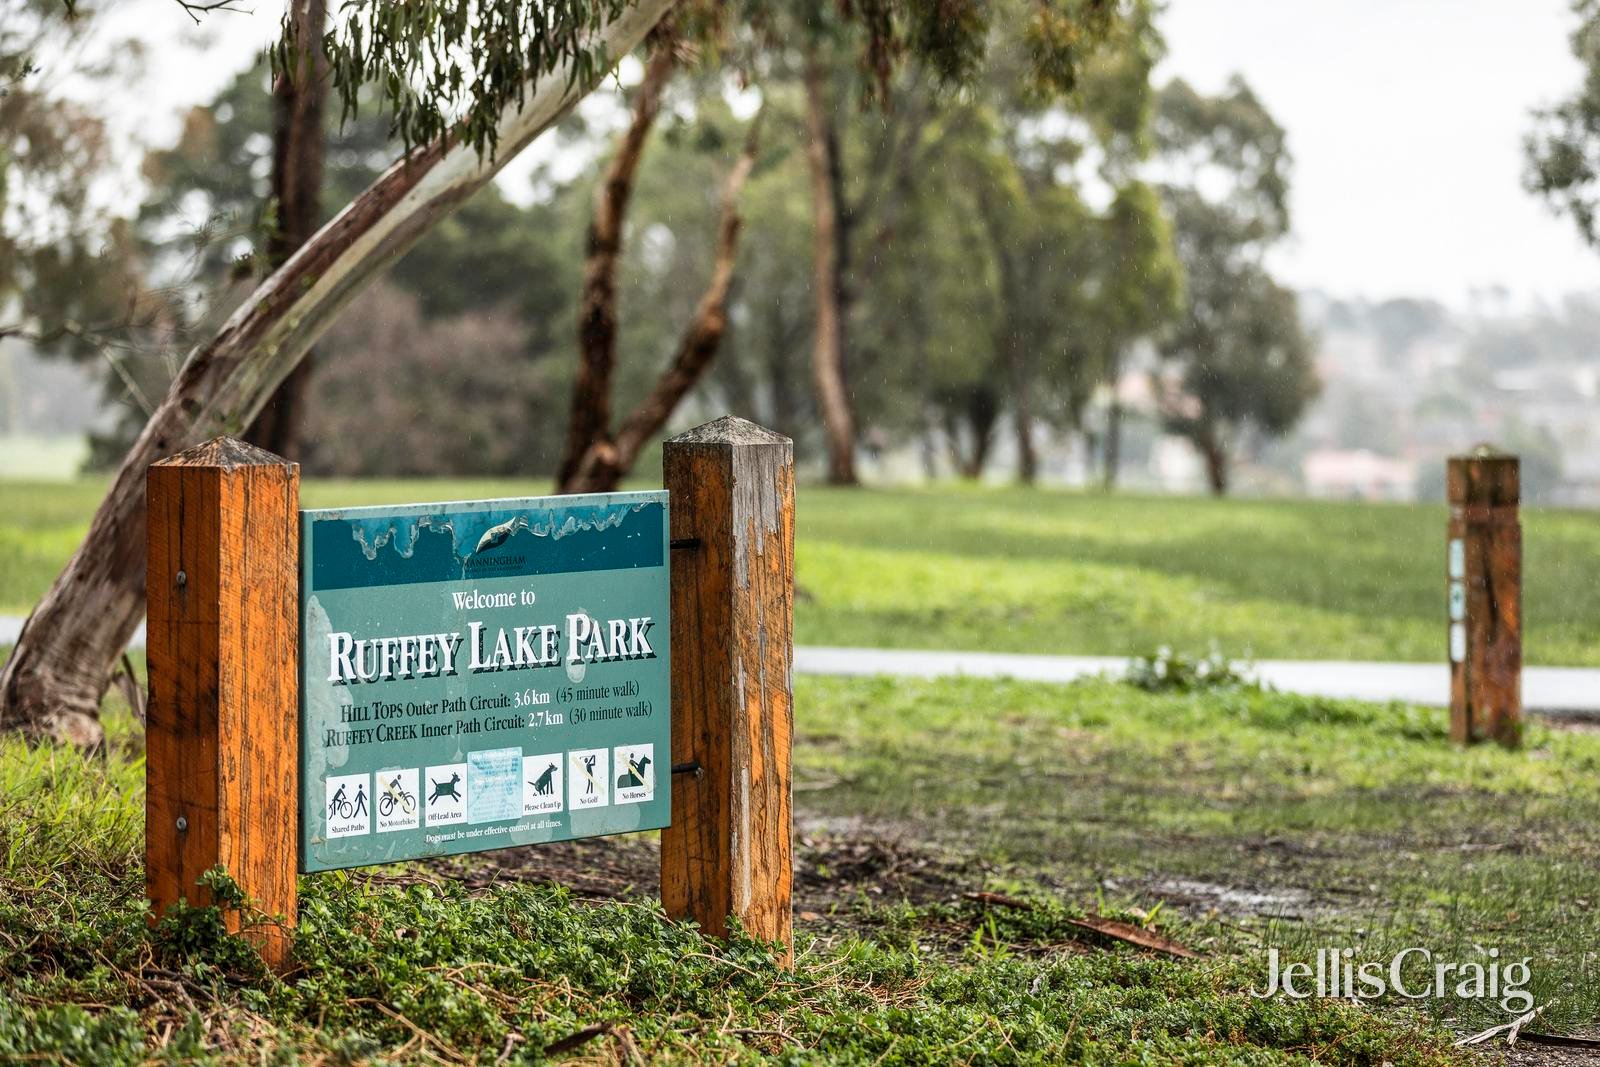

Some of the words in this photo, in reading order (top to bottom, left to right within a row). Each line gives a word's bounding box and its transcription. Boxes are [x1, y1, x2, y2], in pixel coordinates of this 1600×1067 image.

[452, 589, 516, 610] Welcome
[521, 589, 535, 604] to
[327, 632, 462, 684] RUFFEY
[468, 621, 559, 671] LAKE
[566, 613, 655, 663] PARK
[341, 704, 370, 723] HILL
[372, 701, 403, 720] TOPS
[406, 702, 438, 716] Outer
[441, 696, 466, 714] Path
[470, 692, 511, 711] Circuit:
[556, 686, 573, 704] (45
[576, 685, 610, 700] minute
[613, 679, 640, 697] walk)
[326, 729, 374, 747] RUFFEY
[376, 723, 417, 742] CREEK
[421, 723, 453, 738] Inner
[456, 717, 481, 734] Path
[484, 714, 525, 732] Circuit:
[569, 708, 586, 726] (30
[589, 706, 623, 721] minute
[626, 701, 653, 718] walk)
[587, 795, 598, 804] Golf
[629, 791, 646, 799] Horses
[524, 803, 540, 812] Please
[540, 801, 555, 810] Clean
[449, 811, 462, 819] Area
[388, 818, 416, 827] Motorbikes
[332, 824, 350, 834] Shared
[350, 823, 365, 832] Paths
[426, 834, 440, 843] Dogs
[457, 830, 465, 839] be
[466, 828, 483, 838] under
[484, 825, 507, 836] effective
[509, 822, 530, 833] control
[537, 820, 545, 829] all
